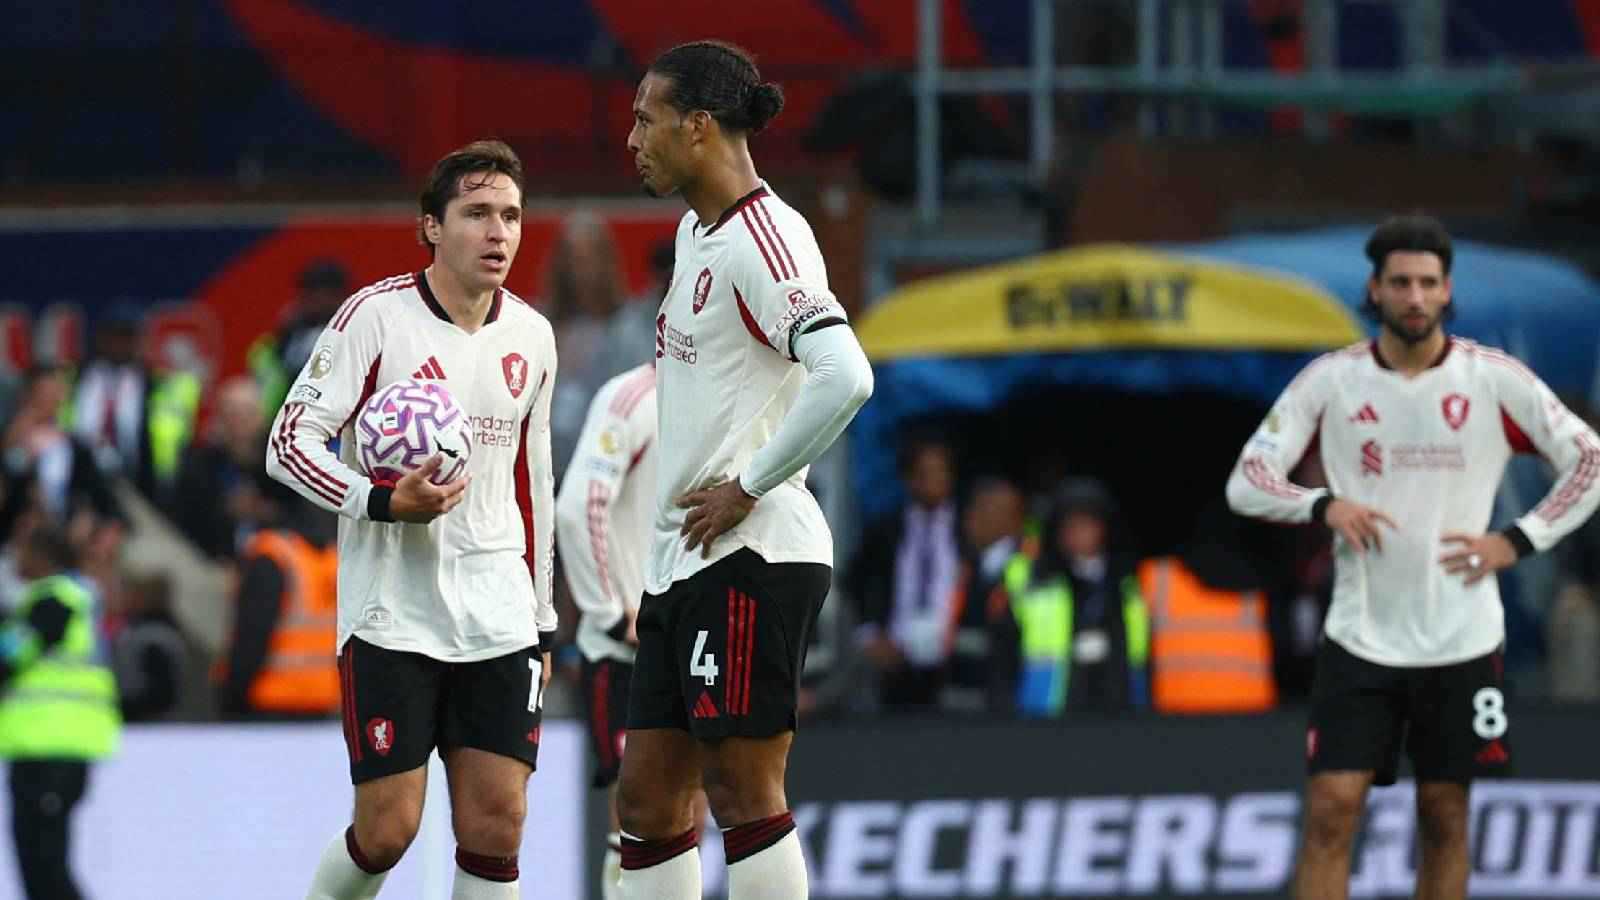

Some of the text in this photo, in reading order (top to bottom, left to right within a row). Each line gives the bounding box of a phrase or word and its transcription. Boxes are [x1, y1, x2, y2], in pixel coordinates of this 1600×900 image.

[789, 306, 829, 335] aptain
[469, 415, 514, 431] ndard
[528, 657, 543, 712] 1
[690, 630, 719, 686] 4
[1472, 687, 1508, 739] 8
[704, 792, 1298, 896] ECHERS
